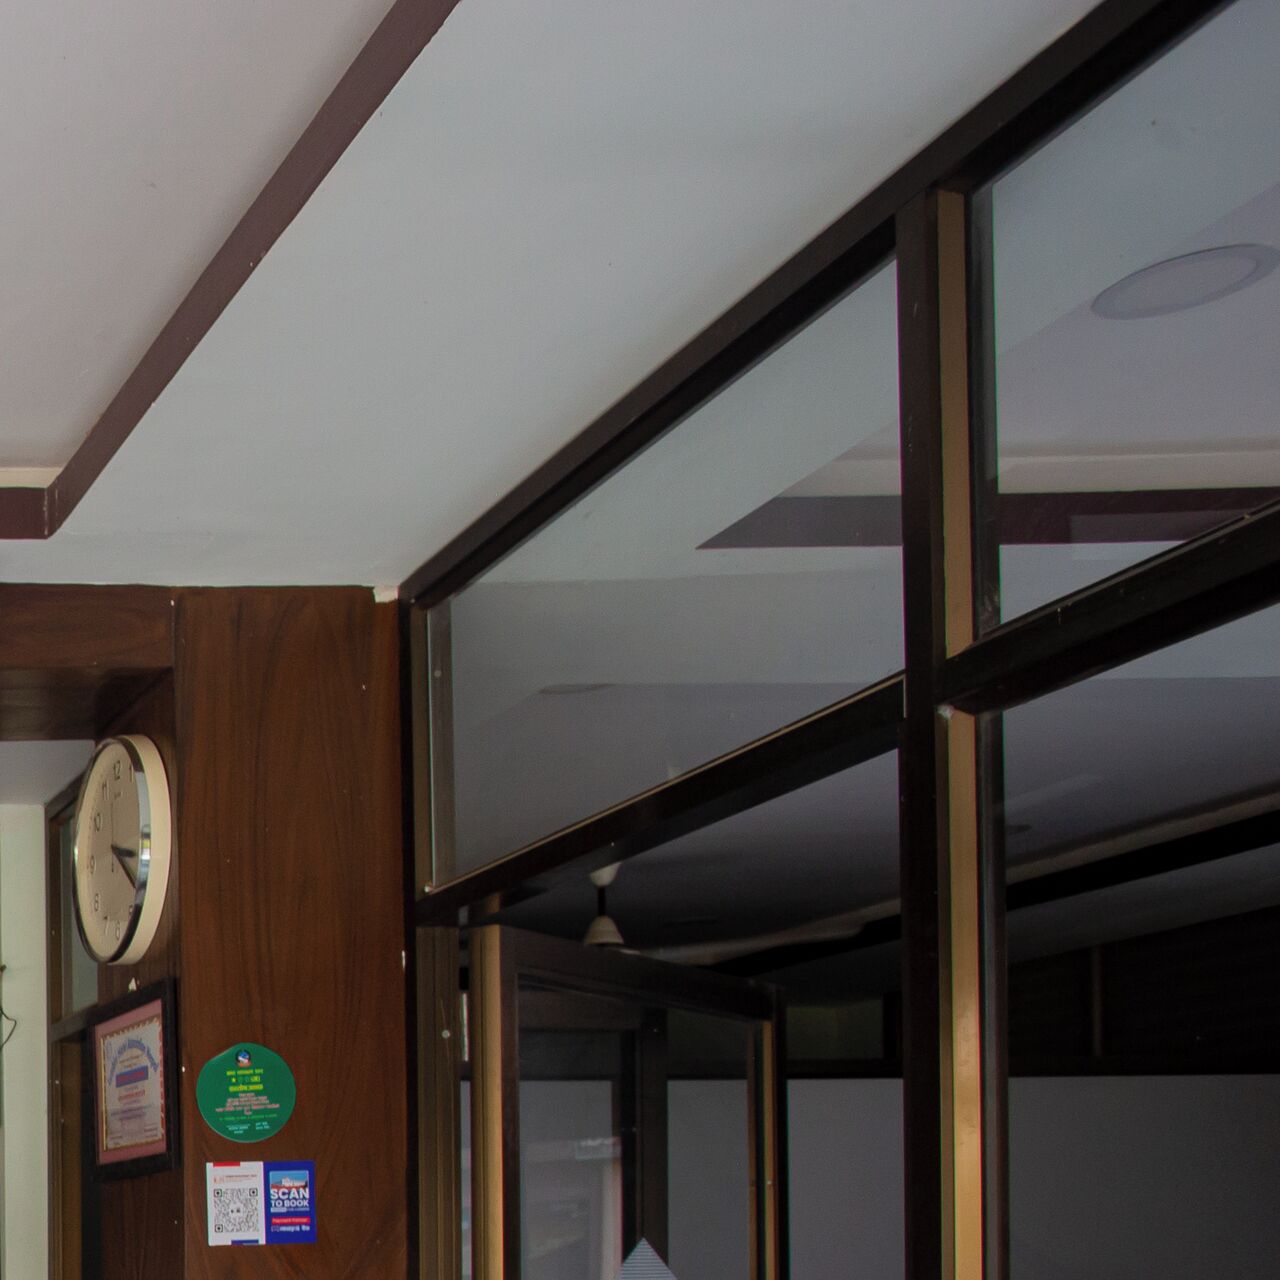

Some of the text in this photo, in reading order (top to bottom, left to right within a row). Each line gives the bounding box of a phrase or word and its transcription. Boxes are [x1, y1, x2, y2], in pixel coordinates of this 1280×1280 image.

[113, 760, 121, 781] 12
[270, 1187, 309, 1199] SCAN
[271, 1199, 309, 1207] TO BOOK
